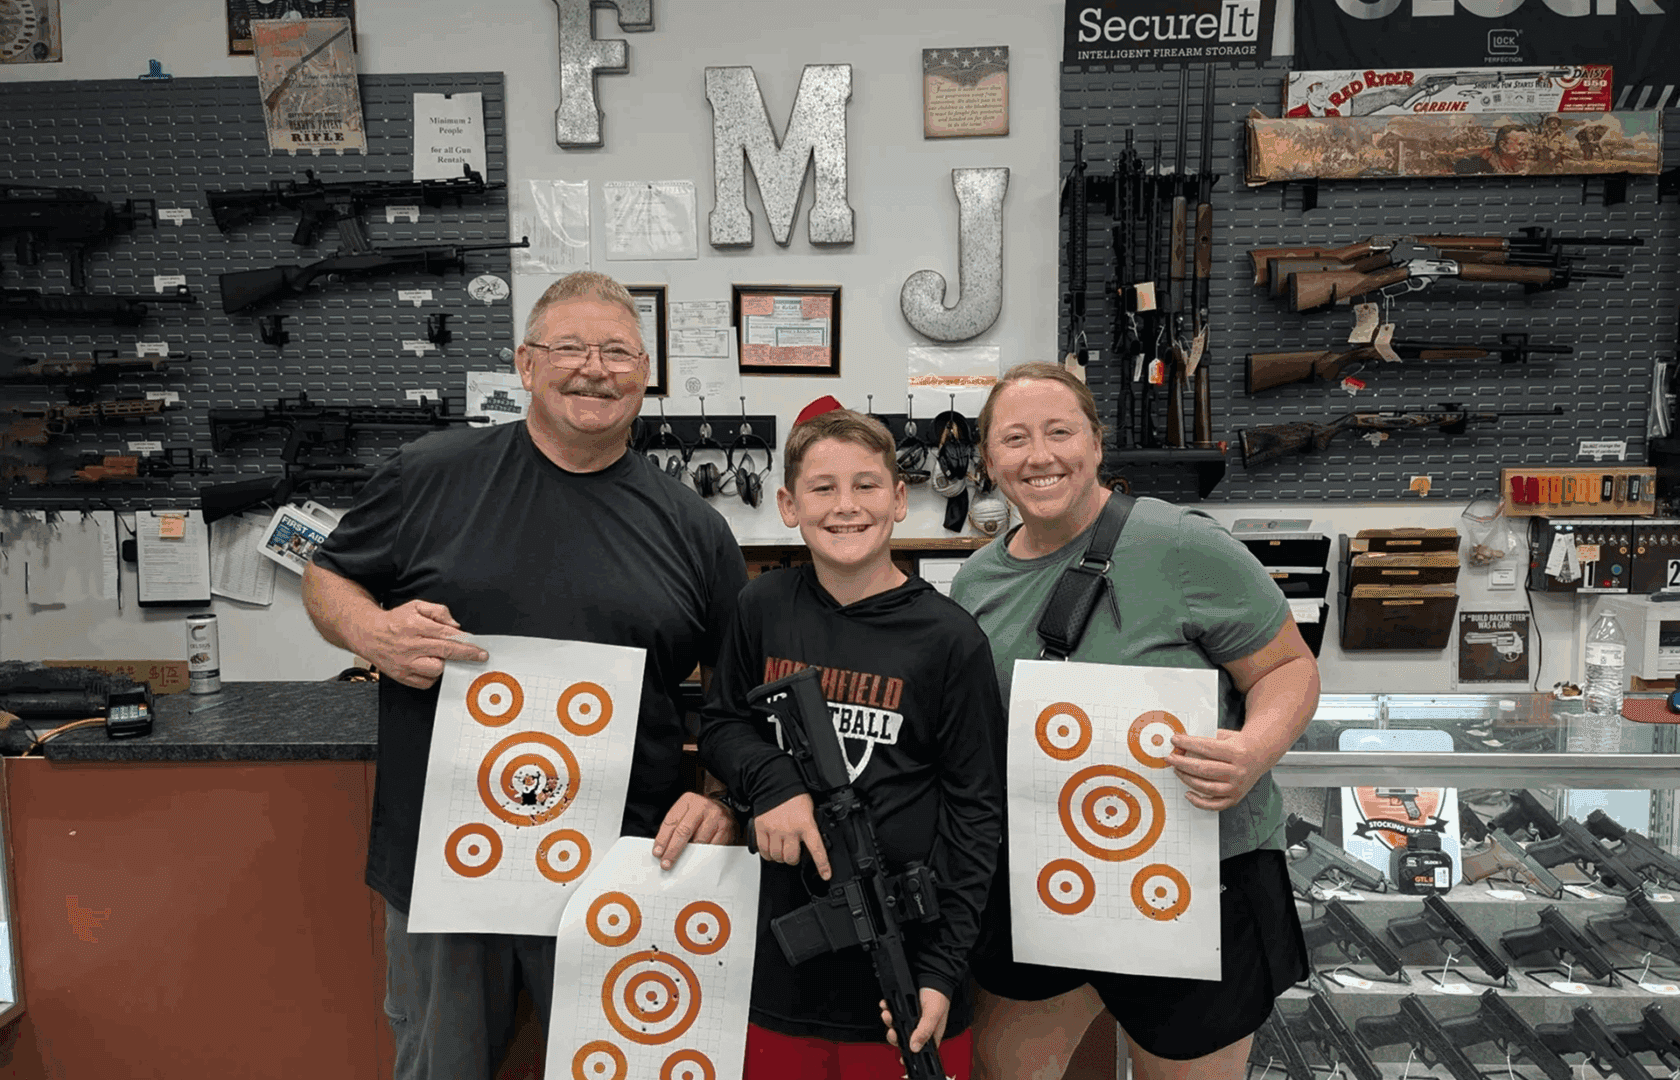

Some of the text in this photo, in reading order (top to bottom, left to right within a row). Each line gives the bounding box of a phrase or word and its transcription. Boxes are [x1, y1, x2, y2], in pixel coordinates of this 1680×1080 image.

[1078, 3, 1256, 43] SecureIt
[1078, 46, 1257, 60] INTELLIGENT FIREARM STORAGE
[1573, 68, 1608, 79] DAISY
[1328, 70, 1415, 108] RED RYDER
[1501, 81, 1513, 89] FUN
[1513, 80, 1535, 89] STARTS
[1413, 101, 1469, 112] CARBINE
[429, 117, 466, 125] Minimum
[291, 132, 345, 142] RIFLE
[439, 127, 463, 136] People
[431, 146, 442, 154] for
[281, 515, 308, 534] FIRST
[308, 532, 325, 544] AID
[1586, 561, 1593, 587] 1
[1669, 560, 1680, 587] 2
[763, 656, 904, 711] NOHFIELD
[1369, 821, 1432, 834] STOCKING DEA
